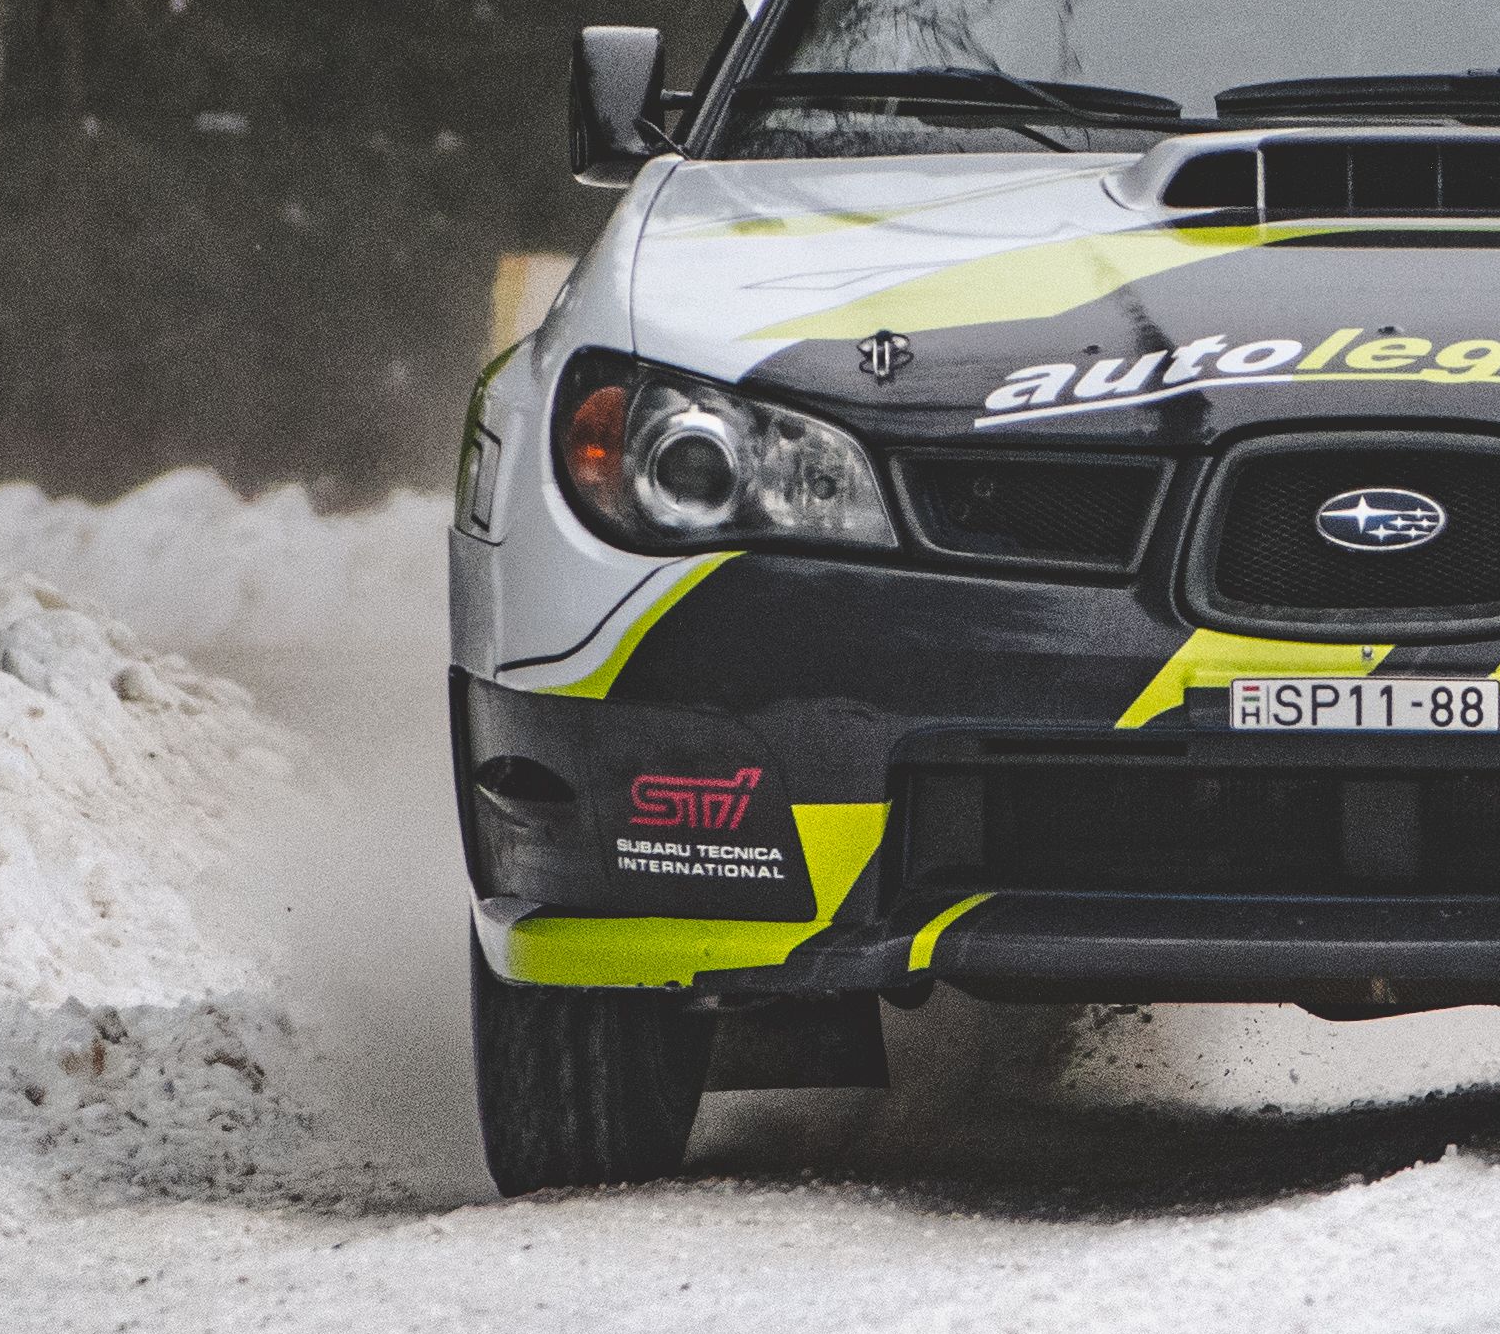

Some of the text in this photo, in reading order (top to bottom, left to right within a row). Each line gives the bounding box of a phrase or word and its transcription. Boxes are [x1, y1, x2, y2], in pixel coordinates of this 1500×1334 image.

[1272, 684, 1484, 728] SP11-88
[616, 838, 783, 860] SUBARU TECNICA
[617, 856, 785, 879] INTERNATIONAL
